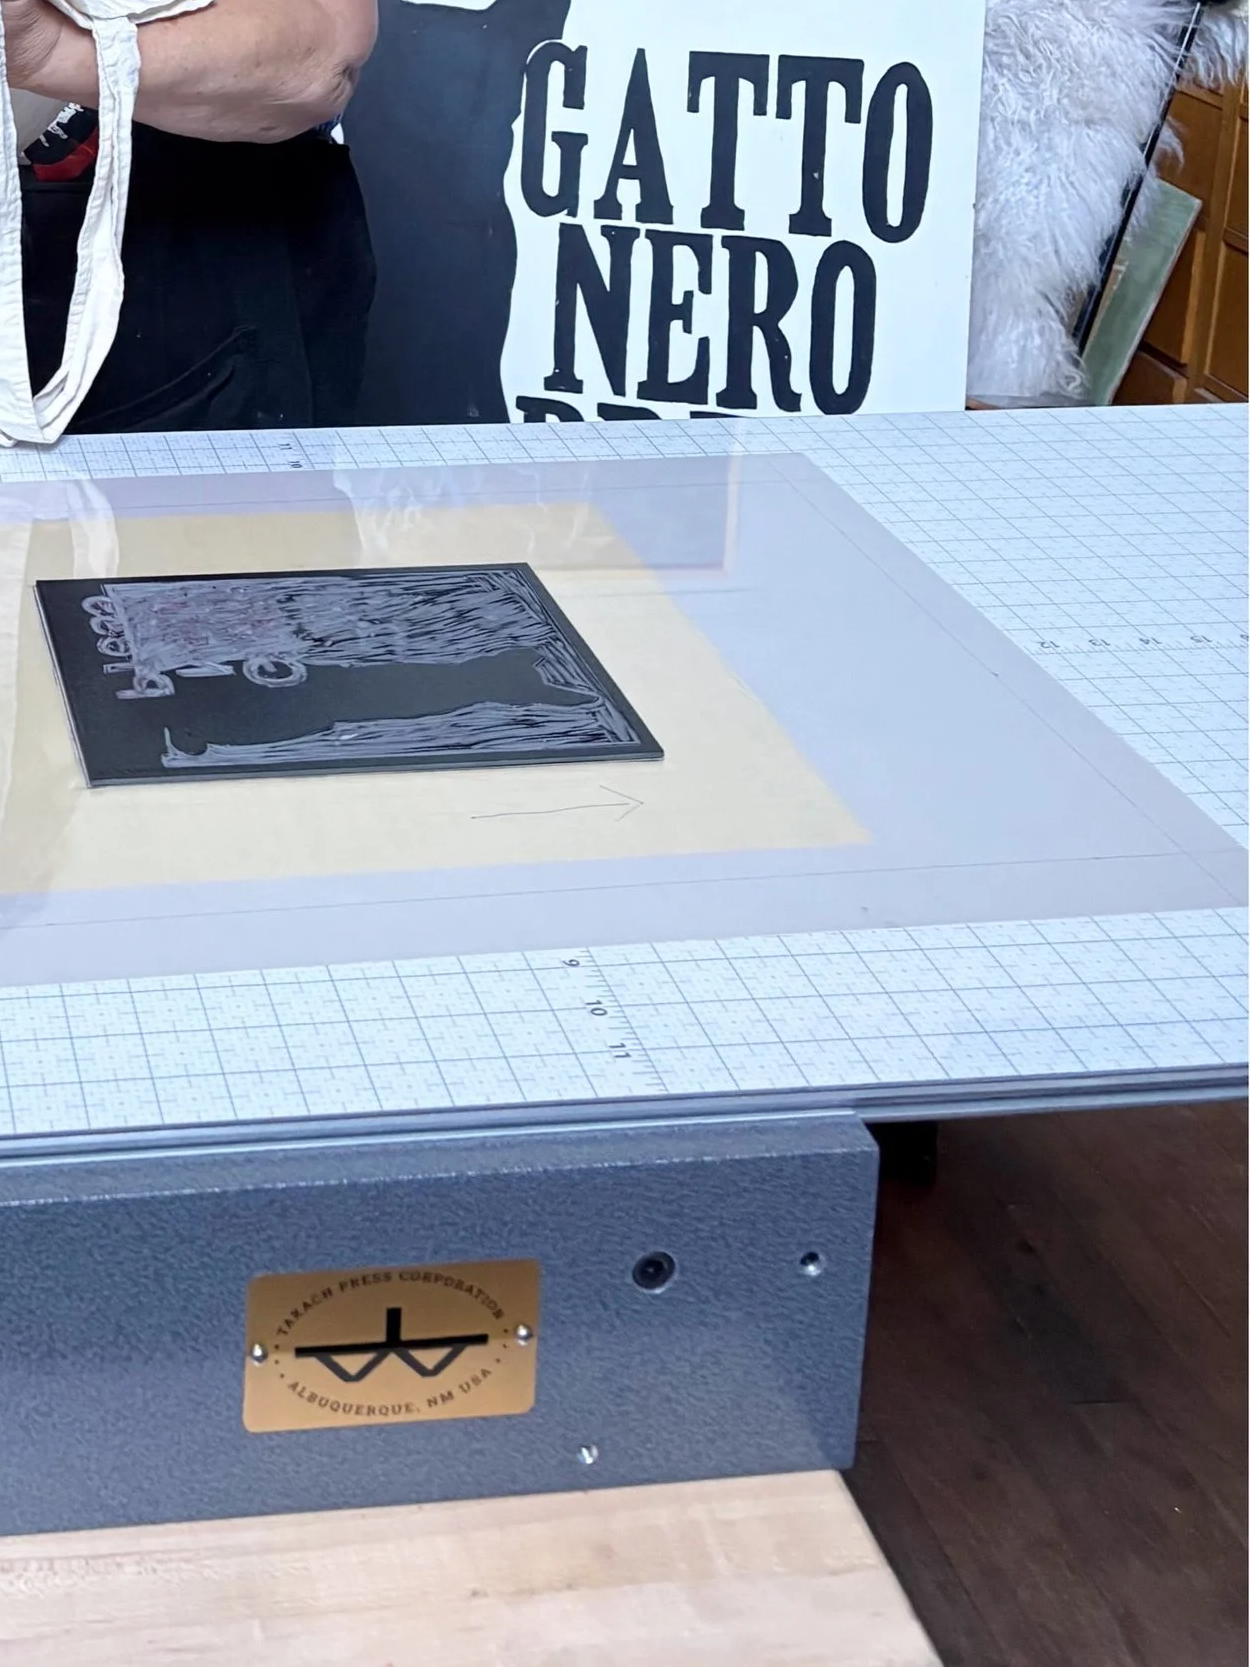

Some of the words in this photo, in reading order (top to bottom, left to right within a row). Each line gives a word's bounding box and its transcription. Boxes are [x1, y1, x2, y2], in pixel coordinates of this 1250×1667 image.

[520, 41, 933, 243] GATTO
[544, 223, 877, 416] NERO
[586, 999, 608, 1017] 10
[609, 1042, 632, 1060] 11
[276, 1286, 334, 1336] TAKACH
[338, 1271, 392, 1293] PRESS
[398, 1271, 505, 1320] CORPORATION
[287, 1380, 421, 1417] ALBUQUERQUE,
[426, 1390, 455, 1409] NM
[459, 1368, 492, 1395] USA
